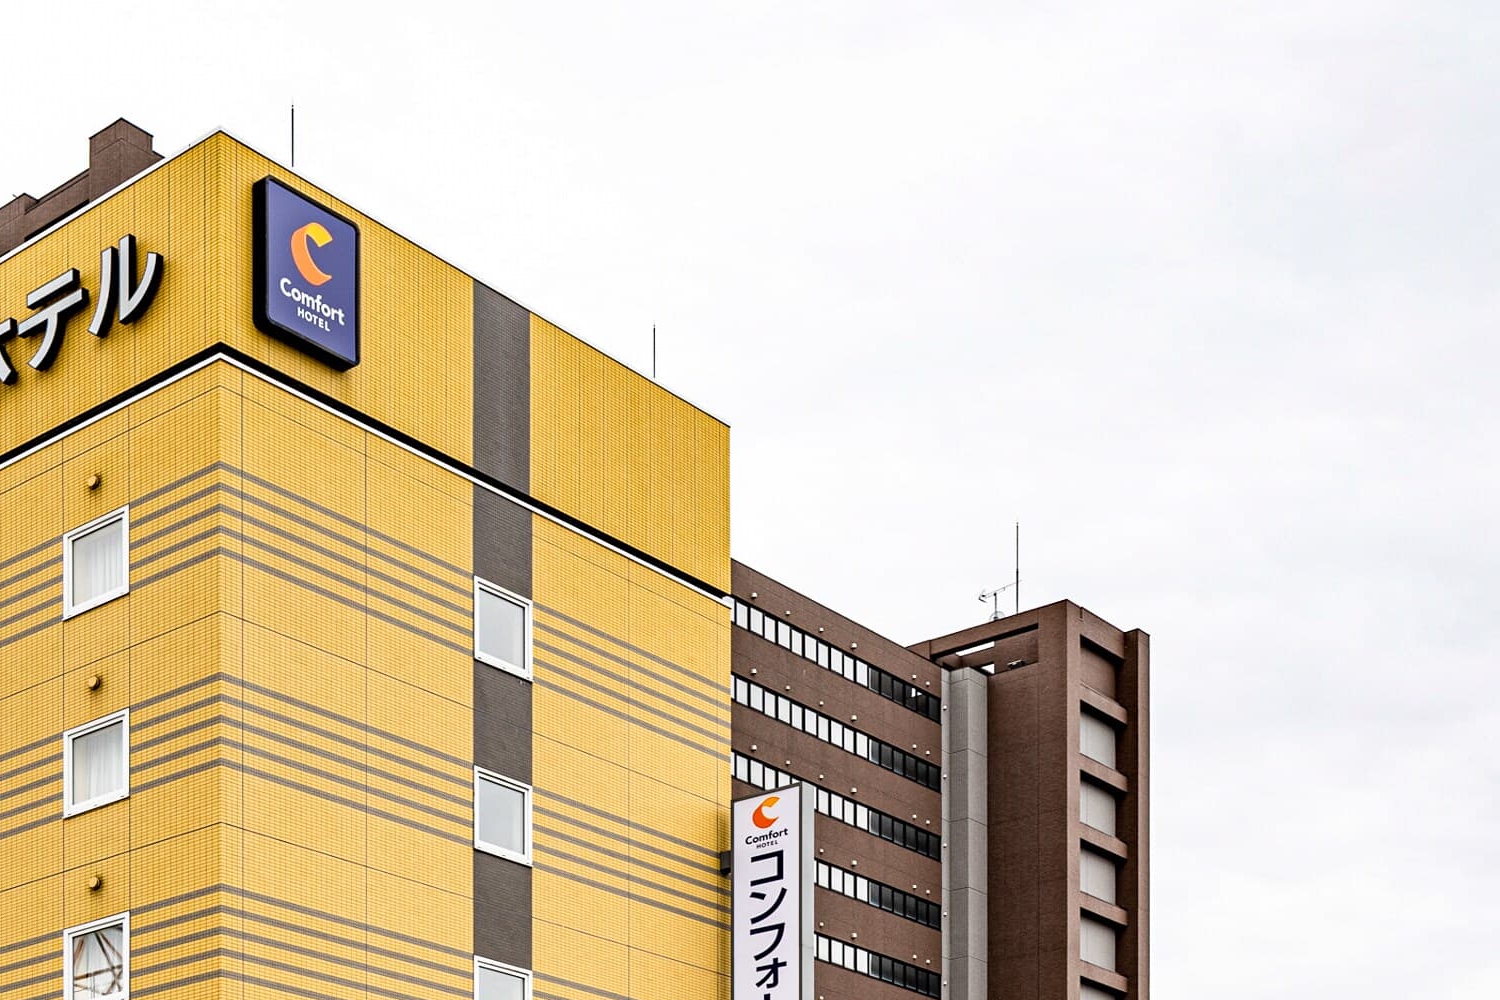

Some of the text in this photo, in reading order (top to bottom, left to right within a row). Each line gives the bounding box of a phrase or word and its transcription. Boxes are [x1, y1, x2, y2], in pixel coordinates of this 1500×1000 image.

[279, 277, 345, 326] Comfort
[297, 307, 331, 332] HOTEL
[745, 827, 788, 846] Comfort
[756, 839, 779, 849] HOTEL
